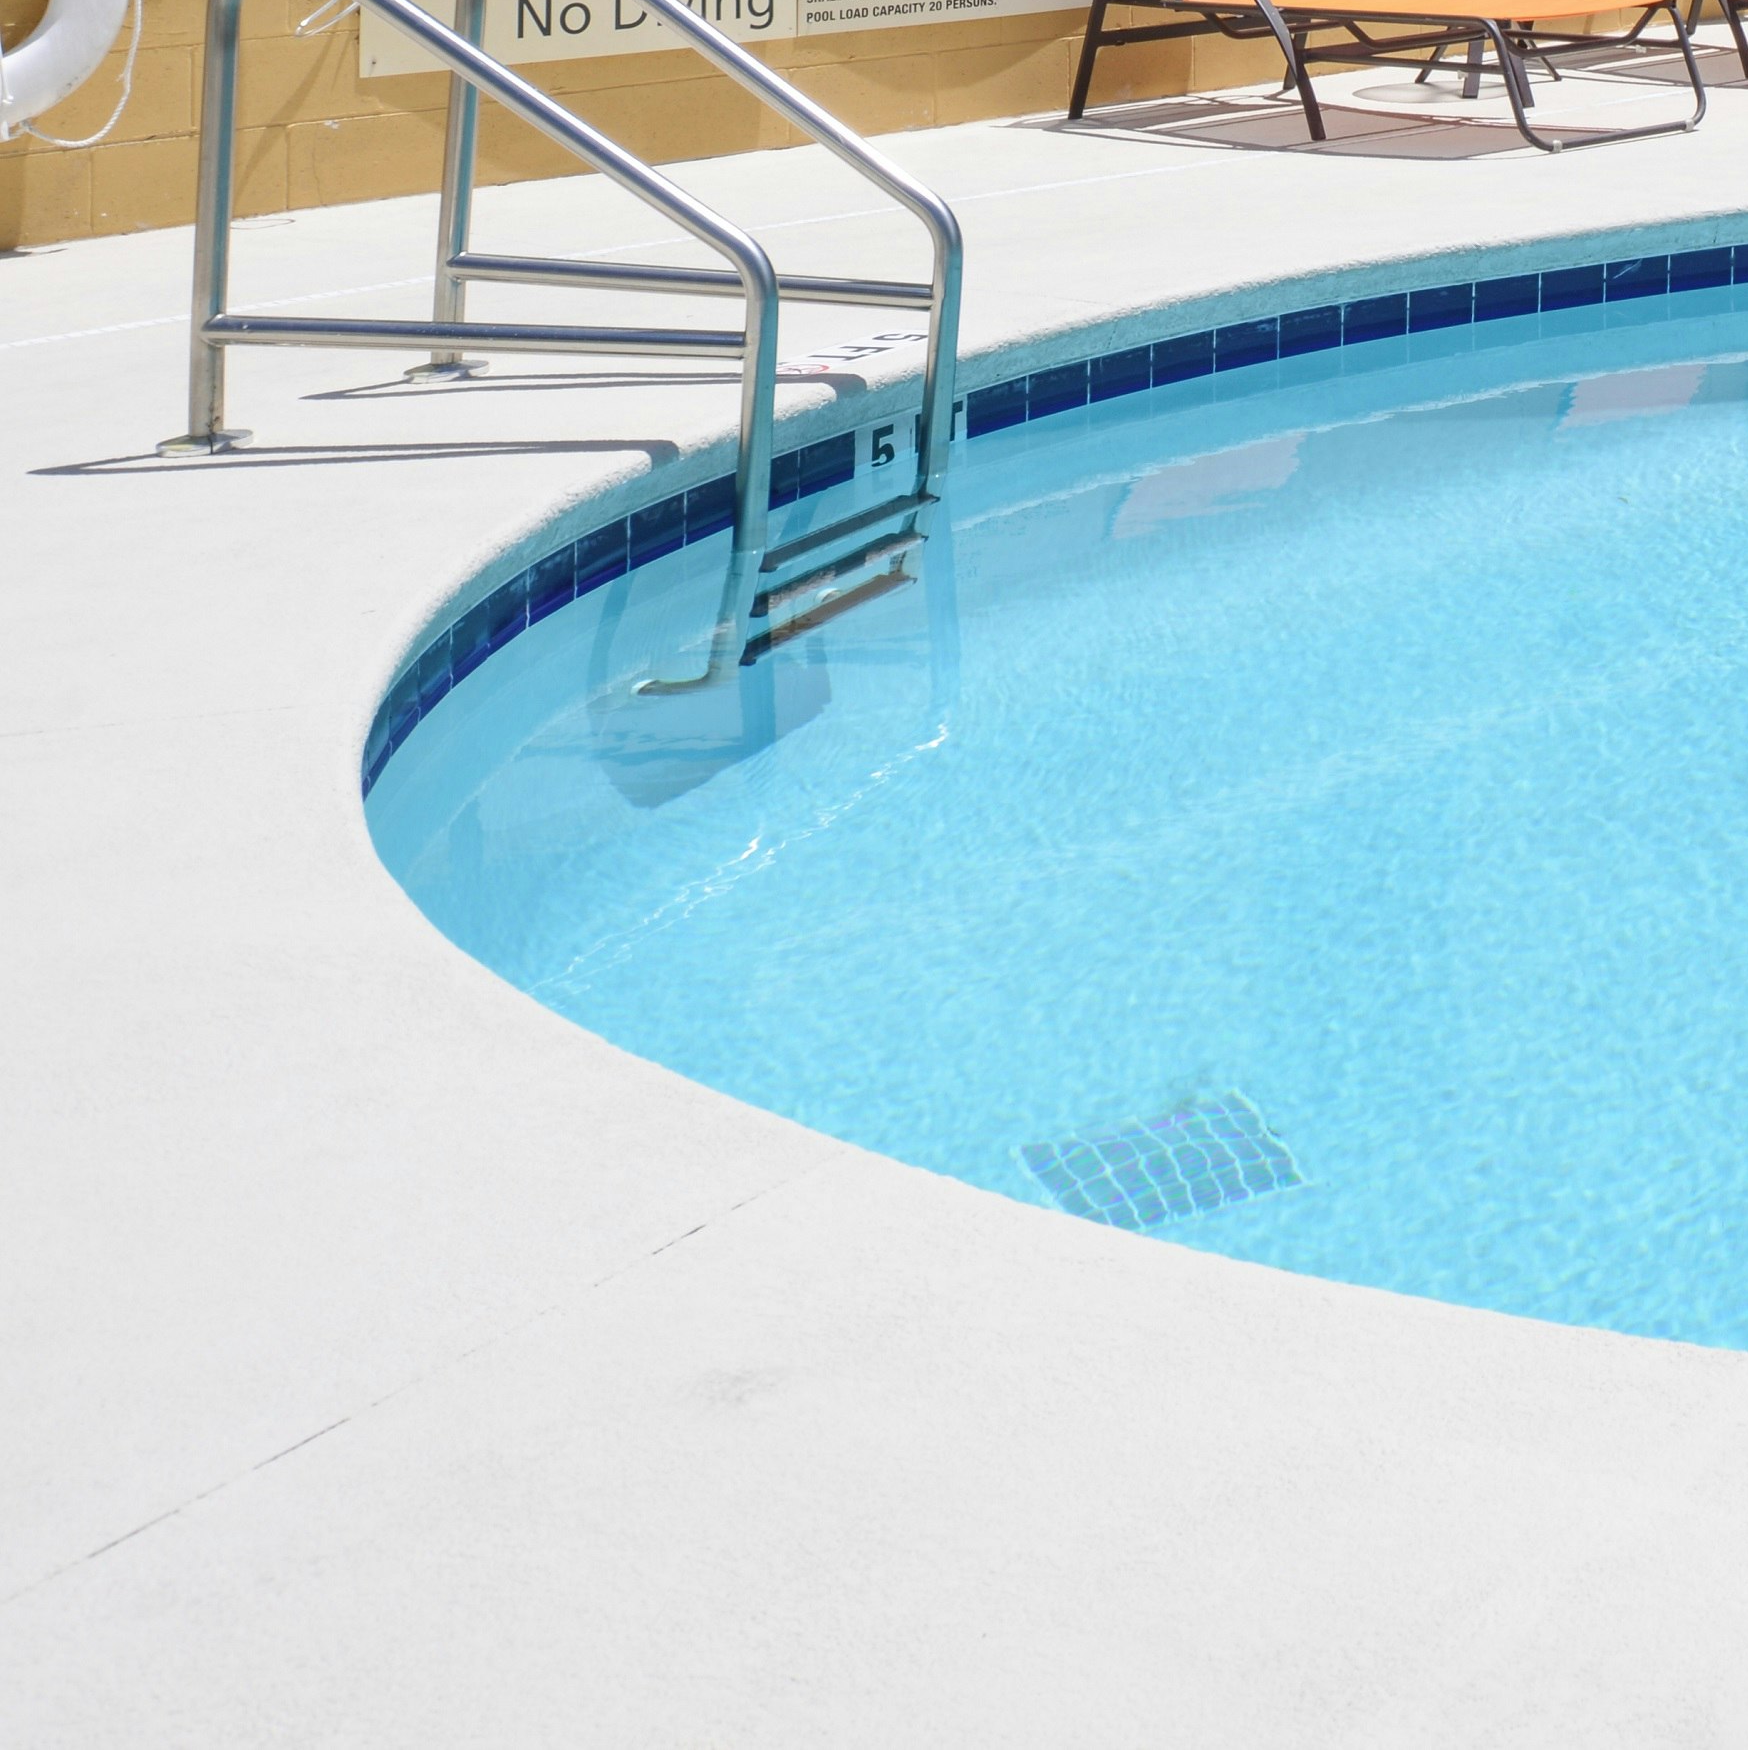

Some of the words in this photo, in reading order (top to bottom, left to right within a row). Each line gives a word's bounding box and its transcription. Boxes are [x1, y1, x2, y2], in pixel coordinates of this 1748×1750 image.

[806, 10, 836, 24] POOL
[840, 7, 868, 20] LOAD
[872, 2, 925, 17] CAPACITY
[929, 0, 942, 11] 20
[871, 424, 895, 468] 5
